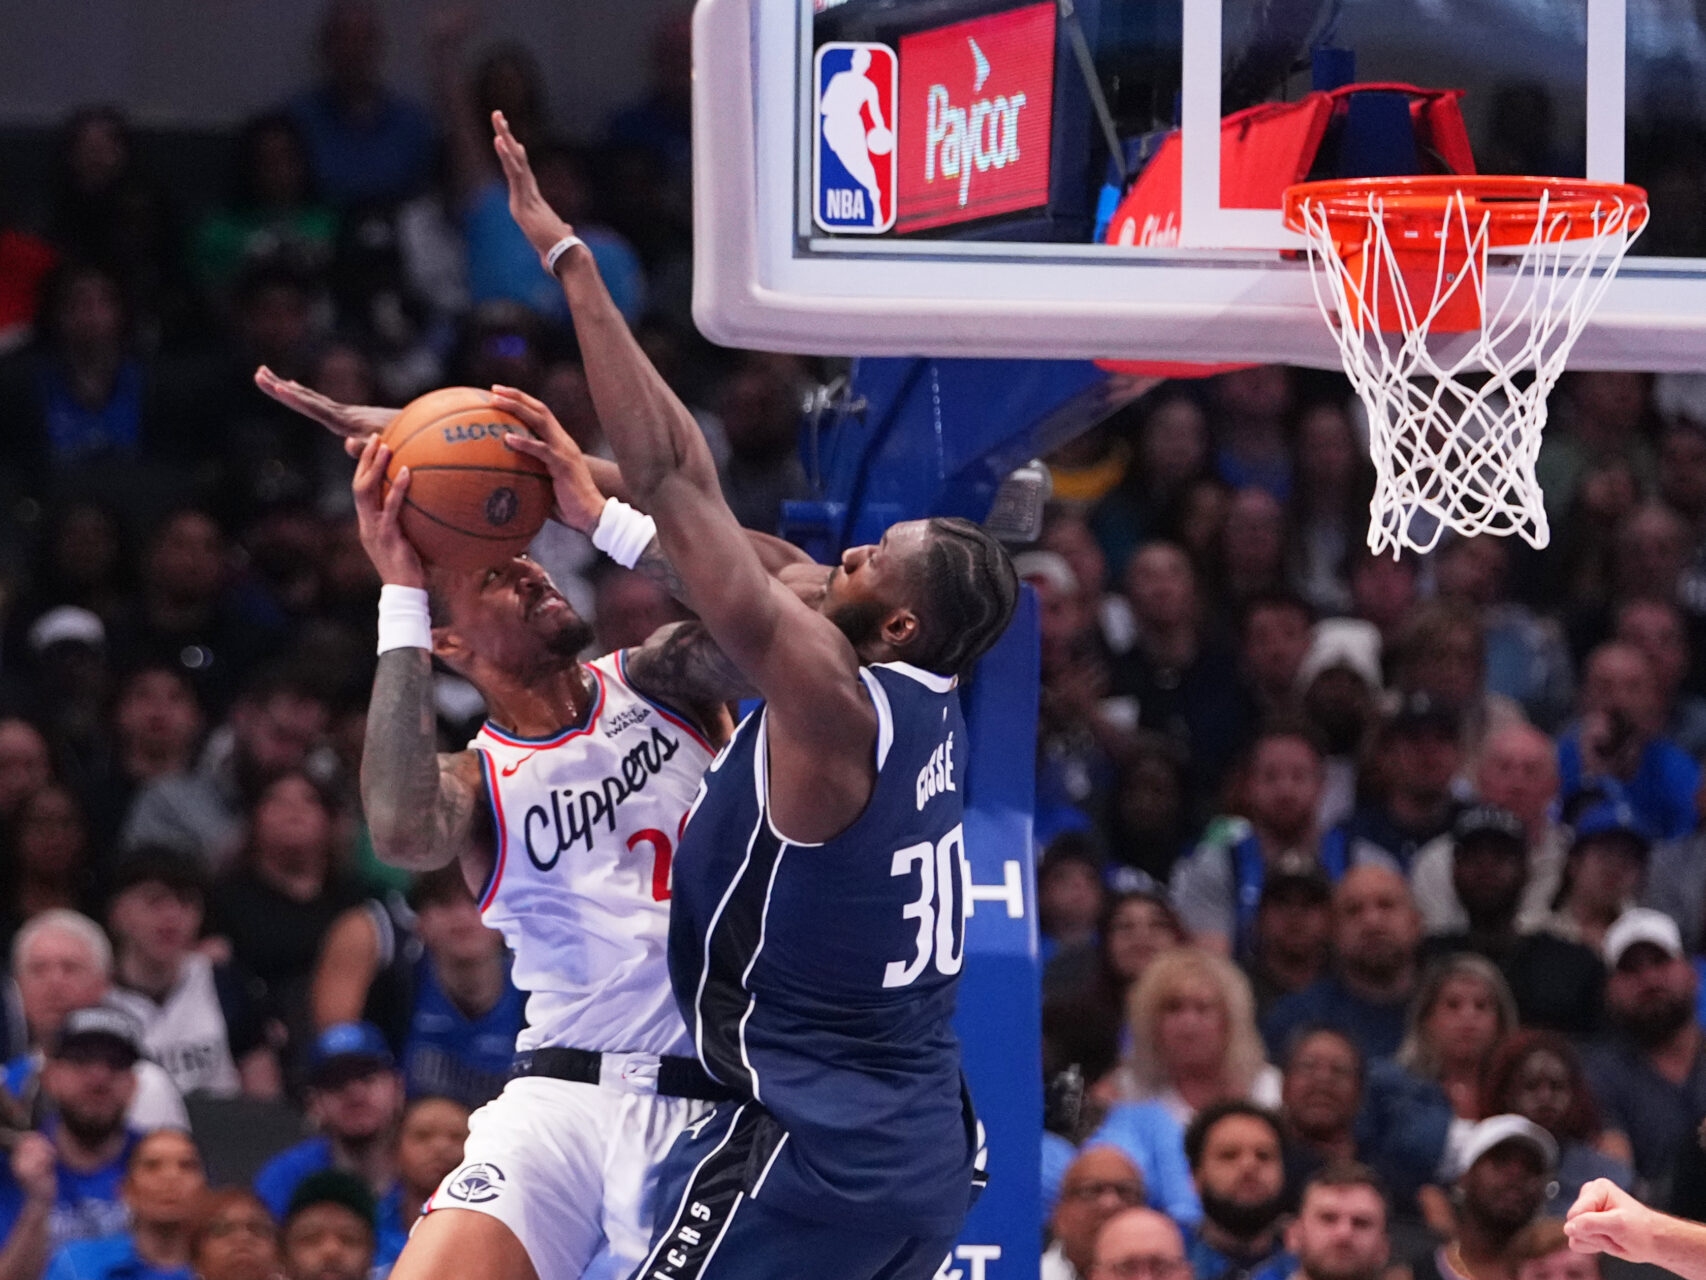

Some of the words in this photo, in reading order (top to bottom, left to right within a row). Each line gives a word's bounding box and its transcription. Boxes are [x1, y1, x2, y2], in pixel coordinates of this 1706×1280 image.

[826, 189, 866, 220] NBA
[925, 83, 1027, 209] Paycor
[524, 726, 680, 872] Clippers
[883, 822, 964, 988] 30
